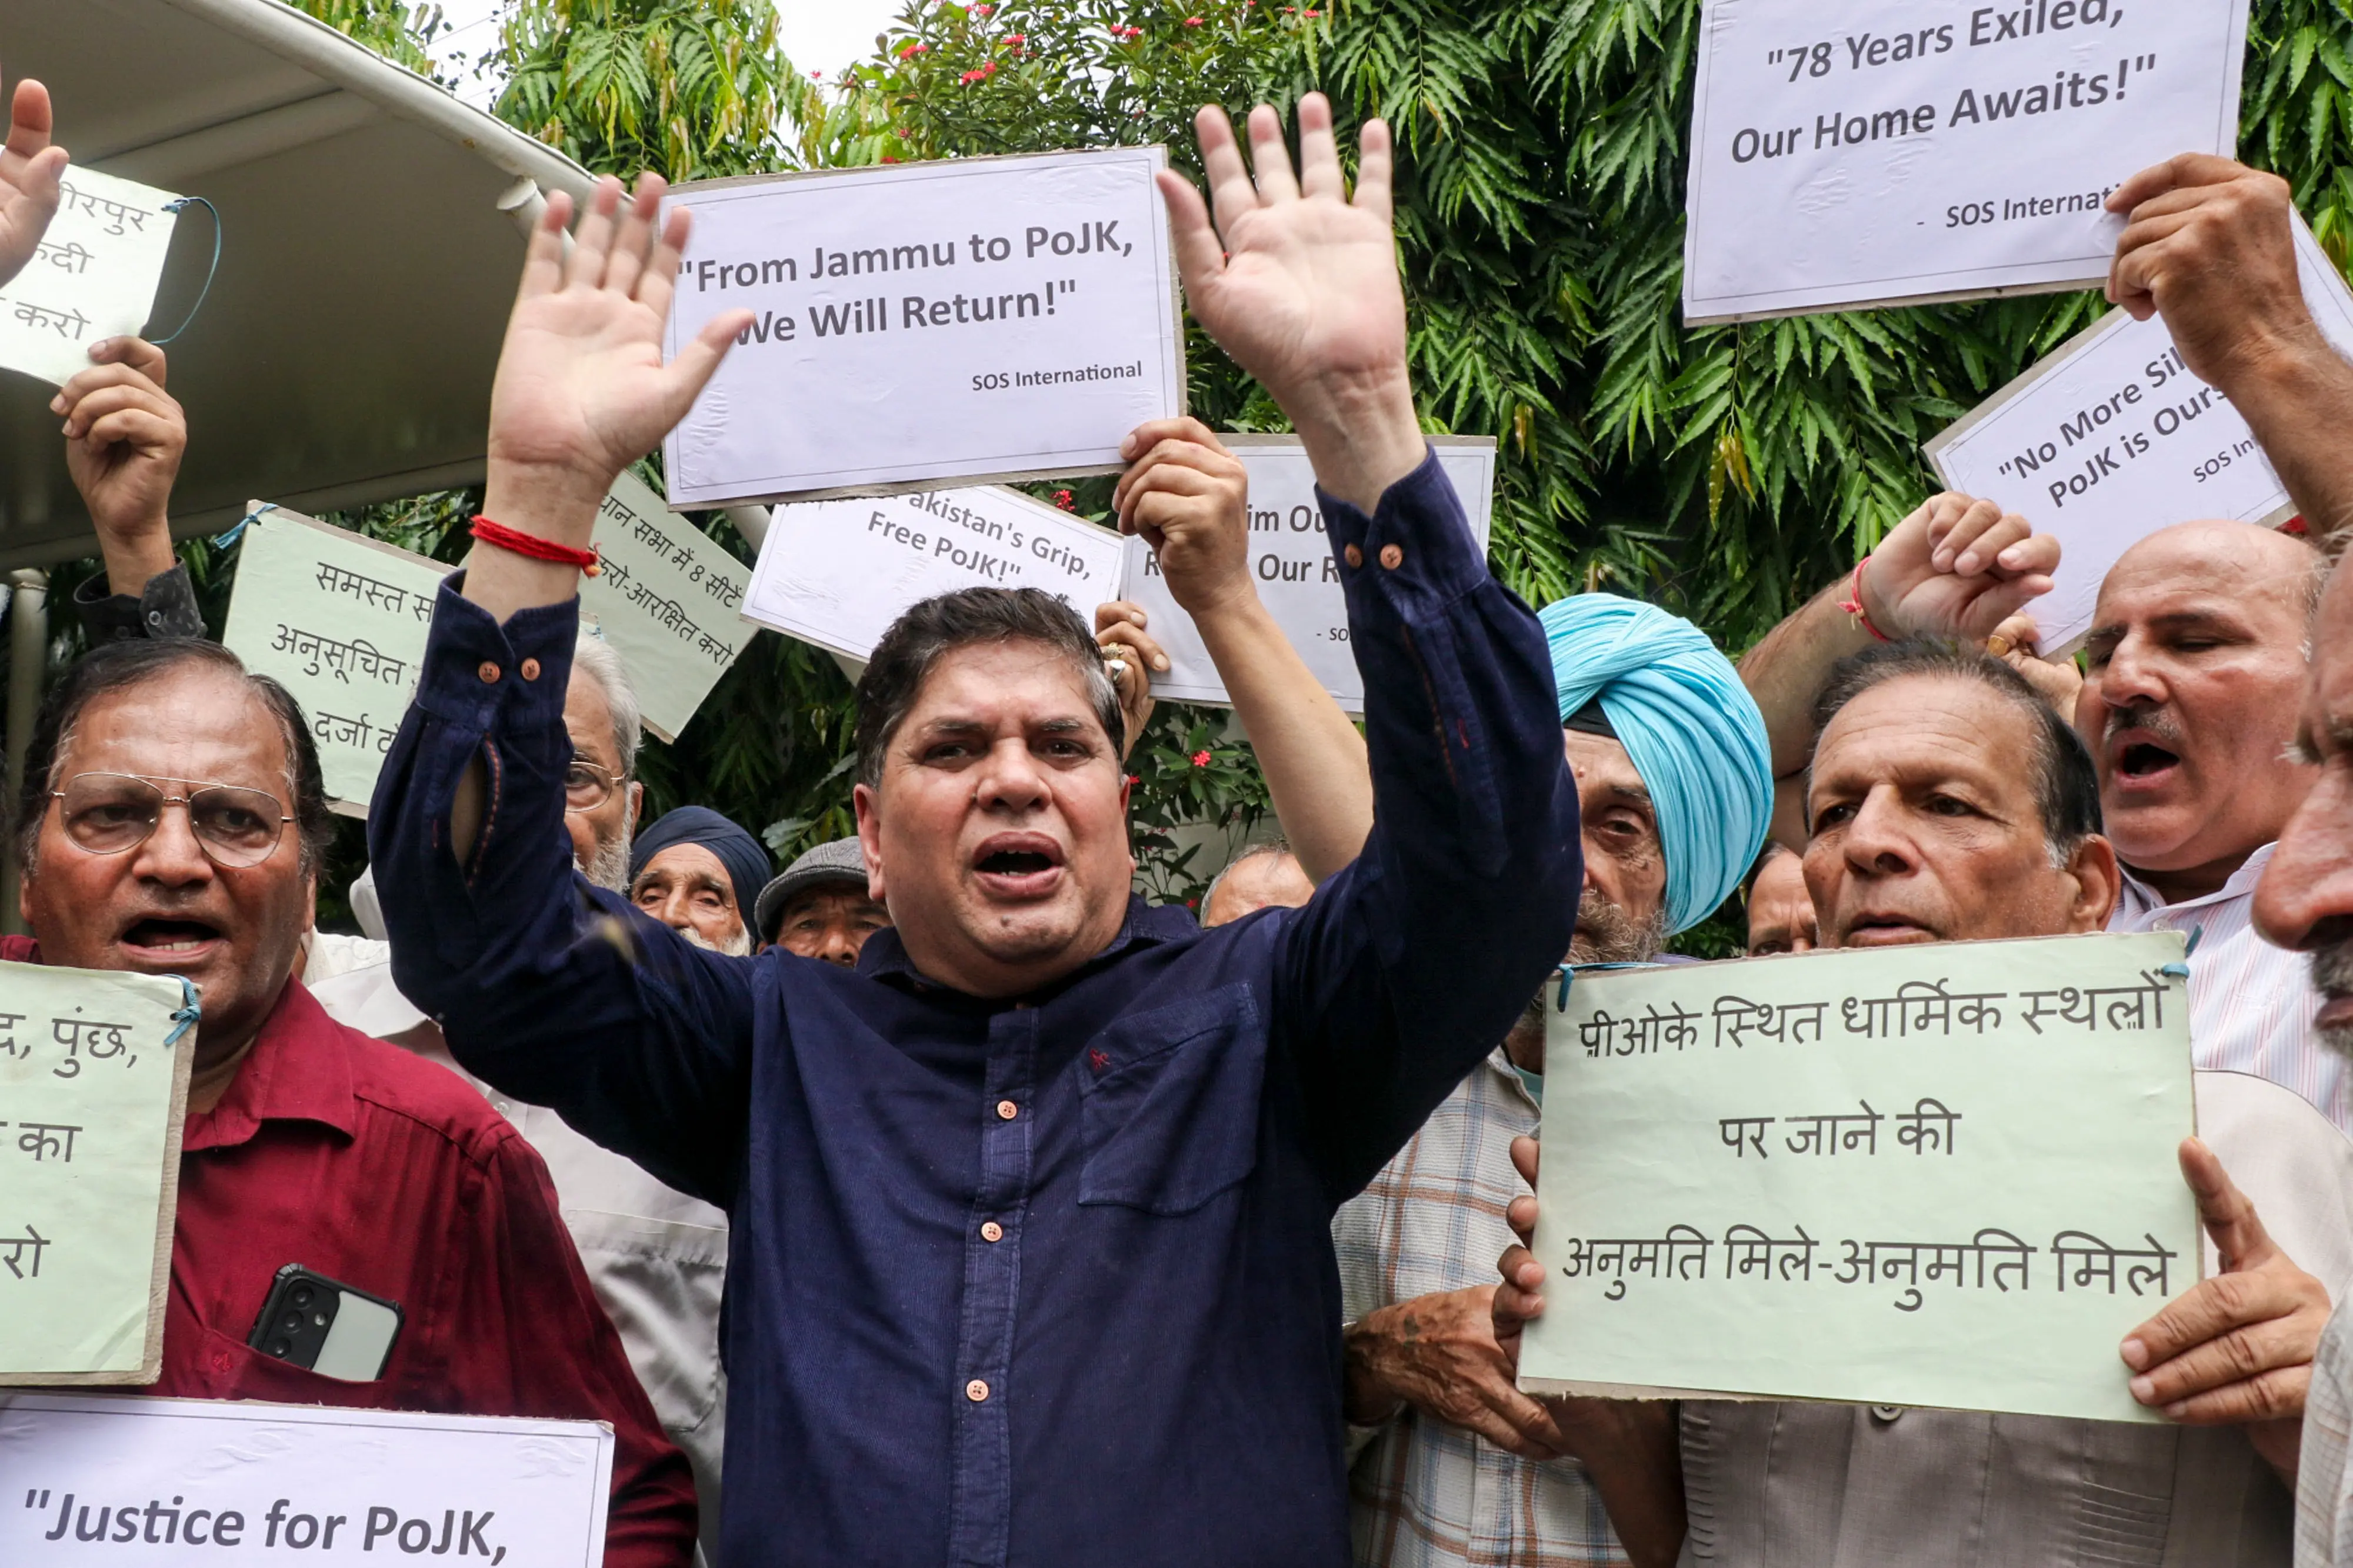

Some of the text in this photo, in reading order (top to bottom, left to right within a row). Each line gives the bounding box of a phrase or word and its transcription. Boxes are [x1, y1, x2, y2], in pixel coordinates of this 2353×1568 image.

[1767, 0, 2124, 84] "78 Years Exiled,
[1731, 54, 2156, 164] Our Home Awaits!"
[1946, 201, 1995, 228] SOS
[678, 219, 1134, 292] "From Jammu to PoJK,
[14, 301, 91, 340] करो
[735, 279, 1076, 346] We Will Return!"
[972, 361, 1143, 391] SOS International
[1999, 438, 2057, 480] "No
[2059, 382, 2143, 448] More
[2048, 447, 2121, 508] PoJK
[2120, 432, 2150, 459] is
[2193, 450, 2232, 483] SOS
[634, 518, 675, 558] सभा
[672, 548, 695, 572] में
[689, 565, 705, 582] 8
[706, 573, 743, 608] सीटें
[867, 510, 1022, 582] Free PoJK!"
[893, 492, 1024, 549] akistan's
[1031, 535, 1091, 581] Grip,
[1258, 553, 1313, 582] Our
[316, 562, 409, 613] समस्त
[271, 622, 407, 685] अनुसूचित
[698, 632, 735, 666] करो
[315, 710, 372, 749] दर्जा
[52, 1006, 138, 1079] पुंछ,
[1578, 969, 2170, 1058] पीओके स्थित धार्मिक स्थलों
[18, 1122, 82, 1163] का
[1720, 1098, 1961, 1159] पर जाने की
[1562, 1225, 1714, 1300] अनुमति
[2051, 1231, 2177, 1296] मिले
[24, 1489, 508, 1566] "Justice for PoJK,
